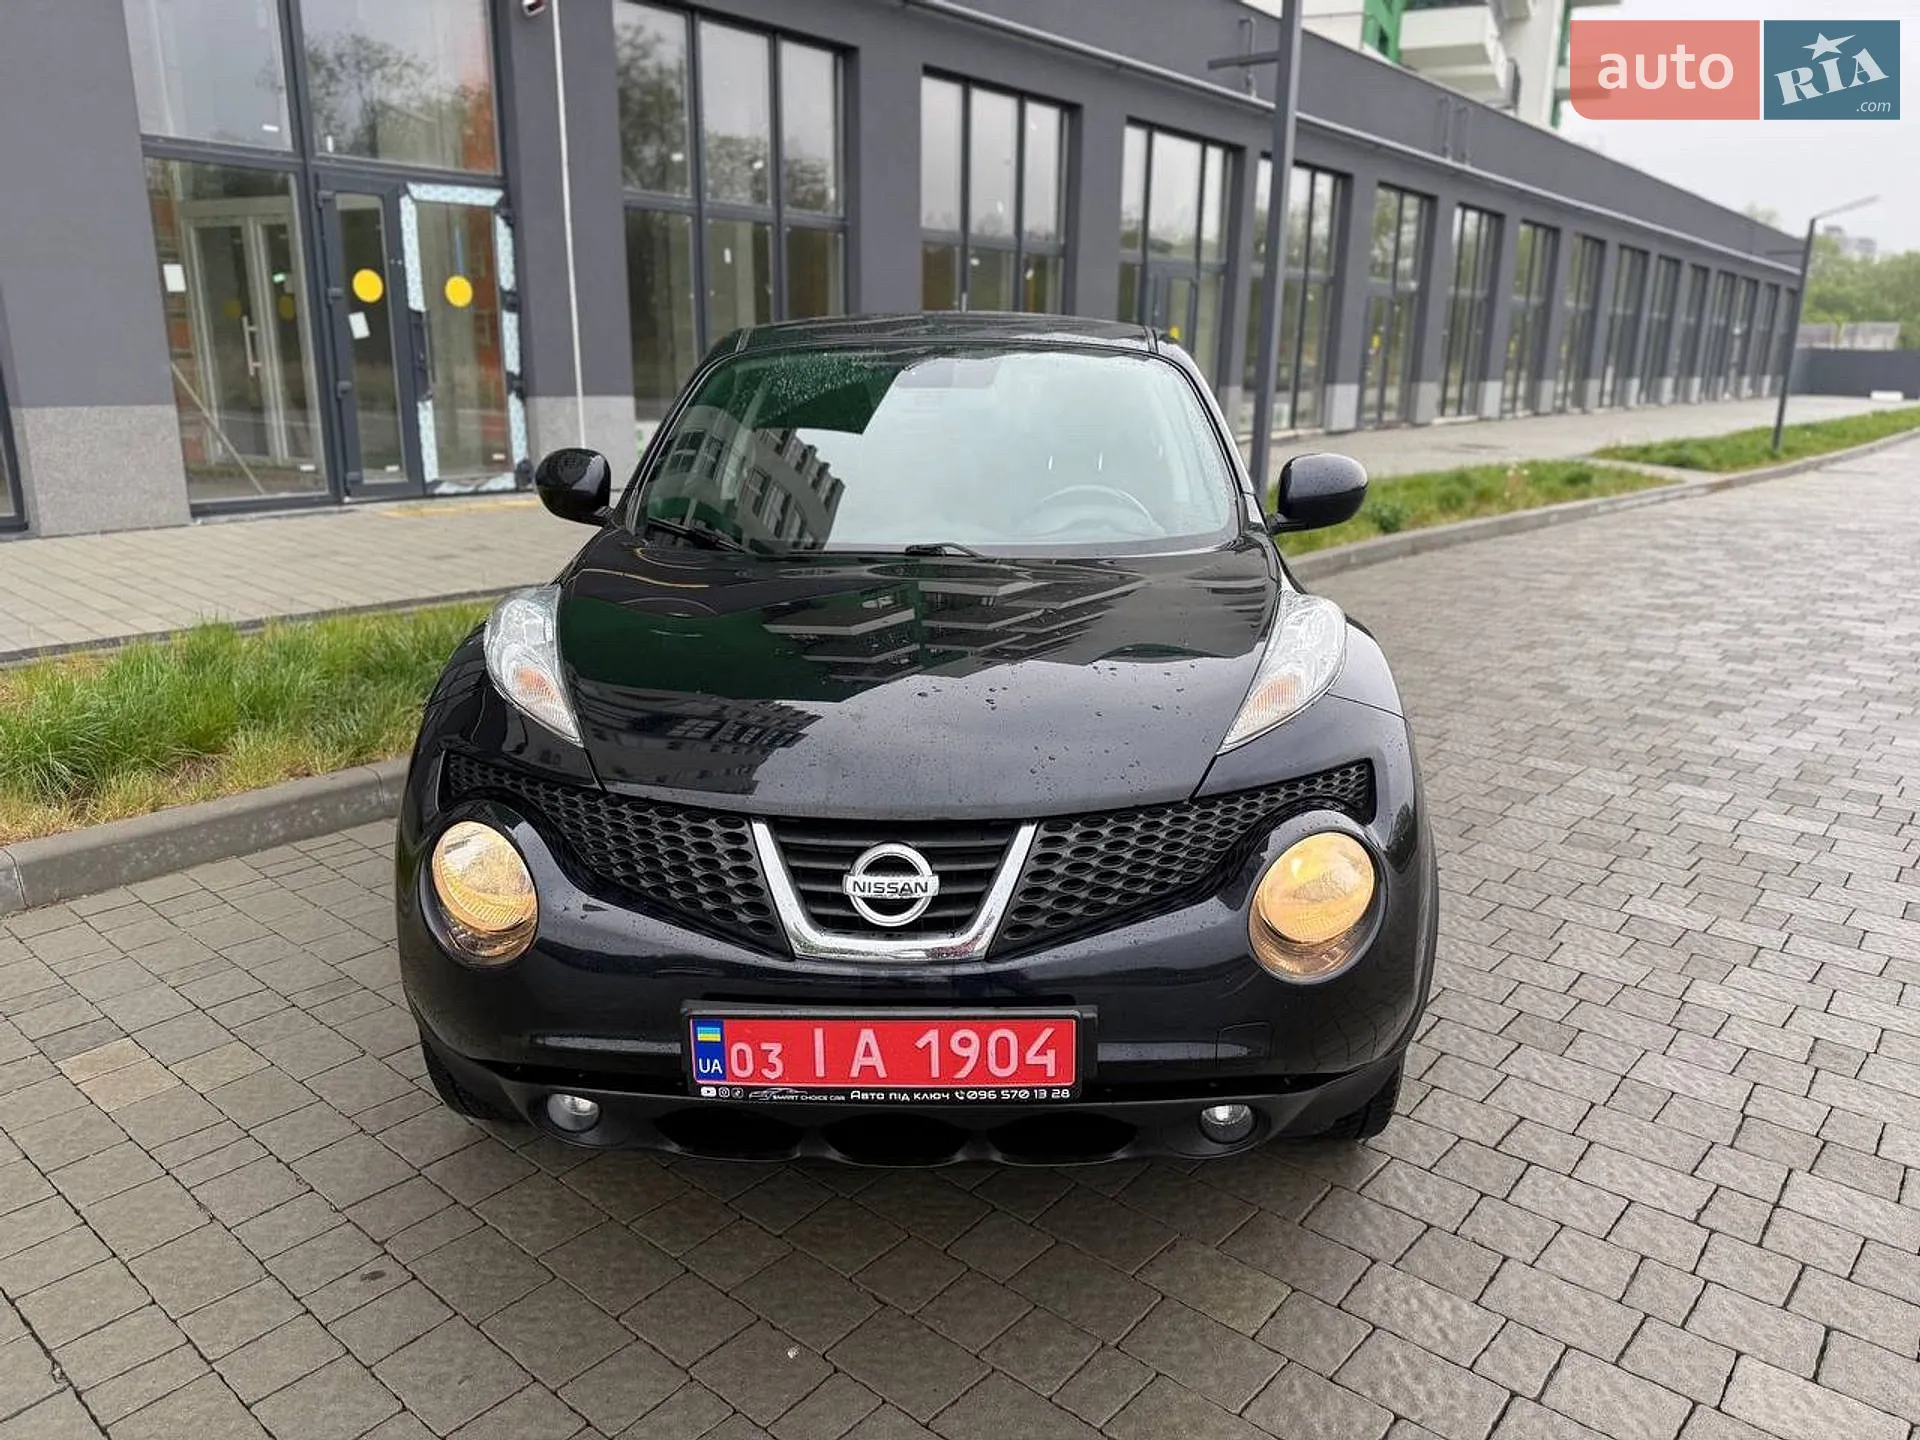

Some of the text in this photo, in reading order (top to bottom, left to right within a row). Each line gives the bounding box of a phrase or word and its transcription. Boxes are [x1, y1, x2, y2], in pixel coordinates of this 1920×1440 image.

[853, 881, 928, 894] NISSAN
[730, 1042, 785, 1079] 03
[914, 1027, 1057, 1079] 1904
[699, 1057, 723, 1074] UA
[966, 1090, 997, 1099] 096
[1001, 1090, 1030, 1099] 570
[1034, 1089, 1048, 1099] 13
[1051, 1089, 1070, 1099] 28
